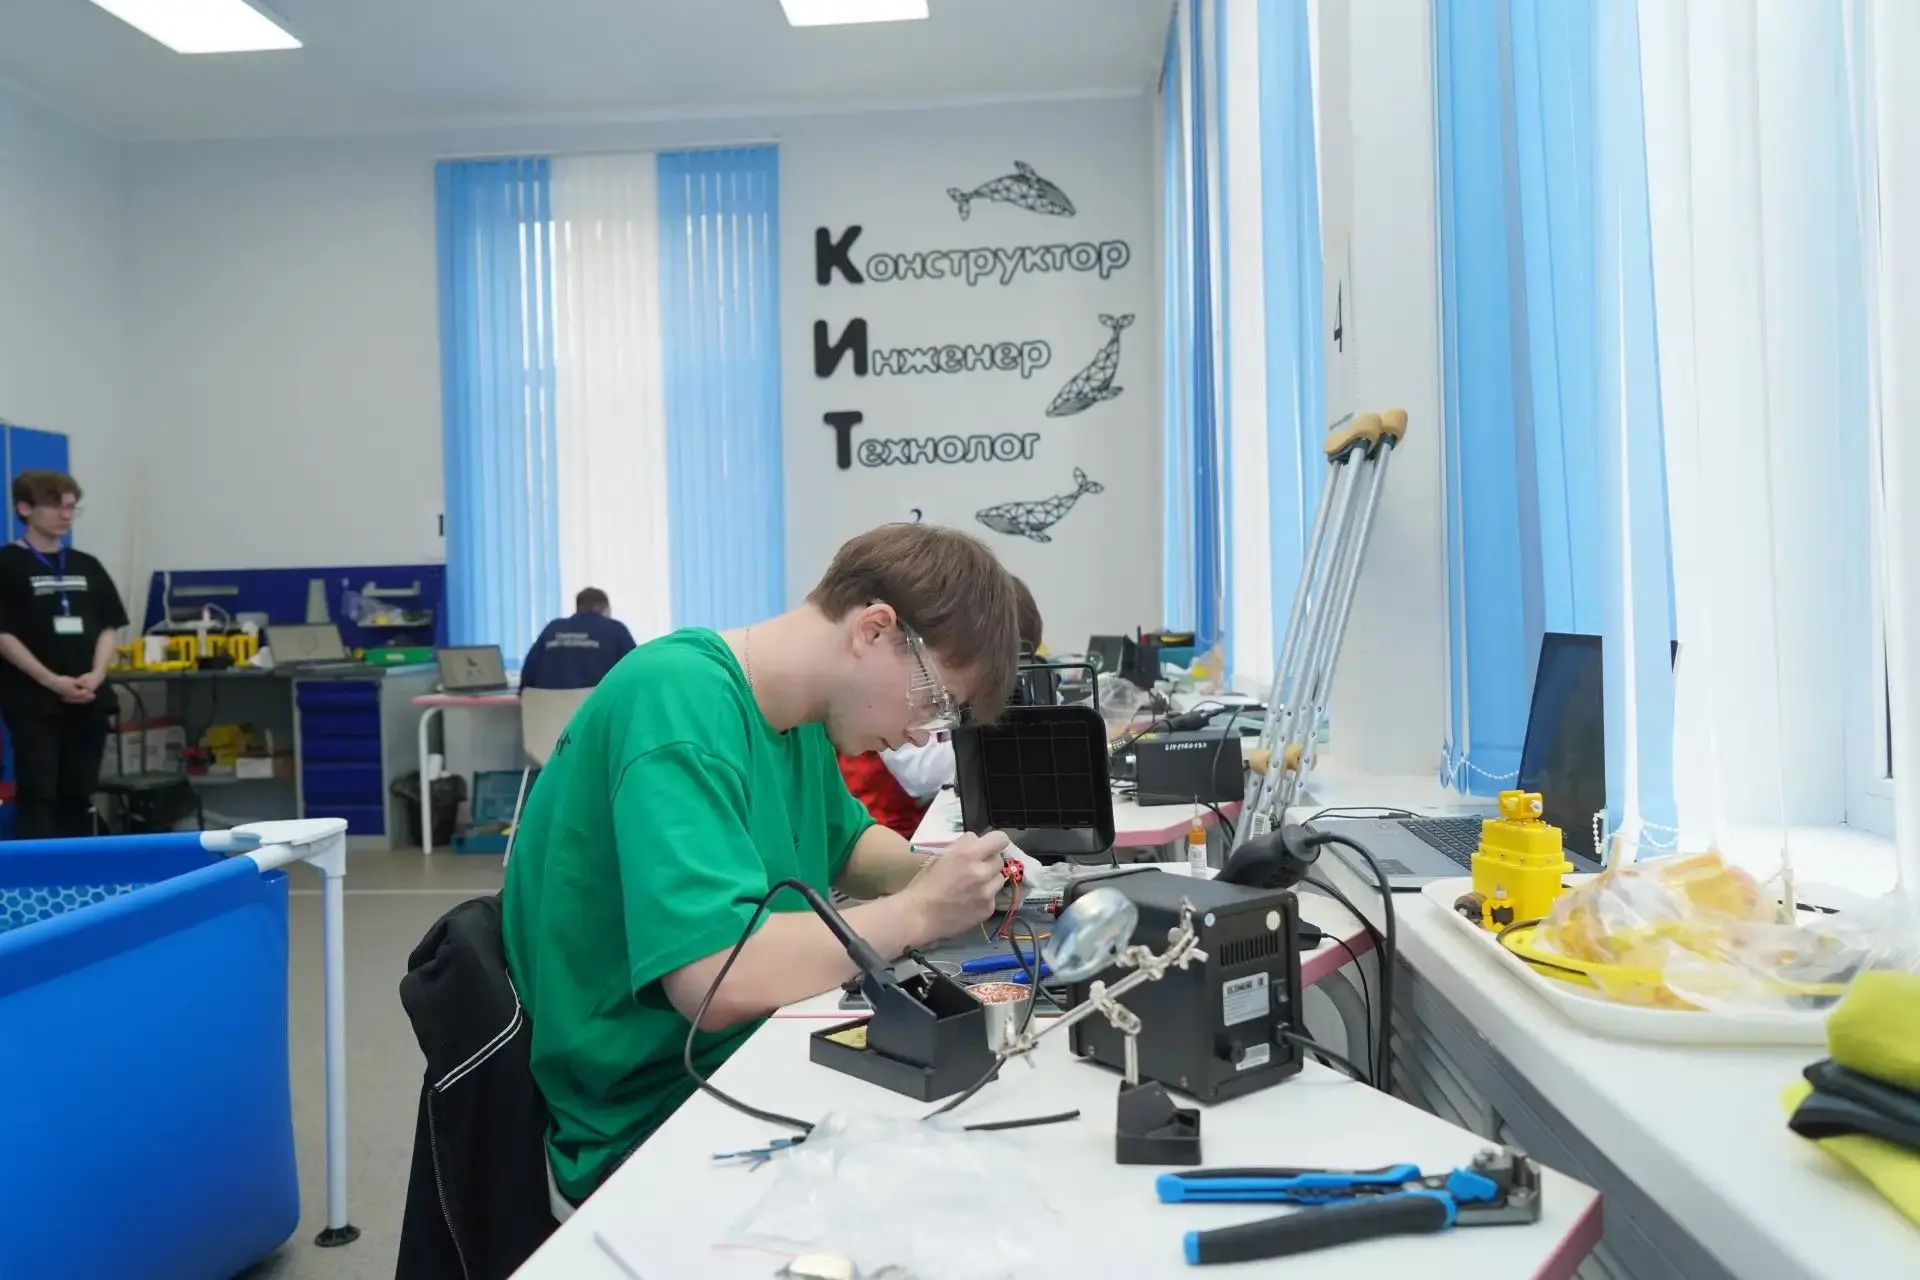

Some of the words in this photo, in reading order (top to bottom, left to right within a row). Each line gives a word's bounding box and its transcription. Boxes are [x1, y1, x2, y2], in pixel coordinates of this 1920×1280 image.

[814, 225, 1130, 286] Конструктор
[814, 318, 1051, 379] Инженер
[823, 411, 1041, 470] Технолог
